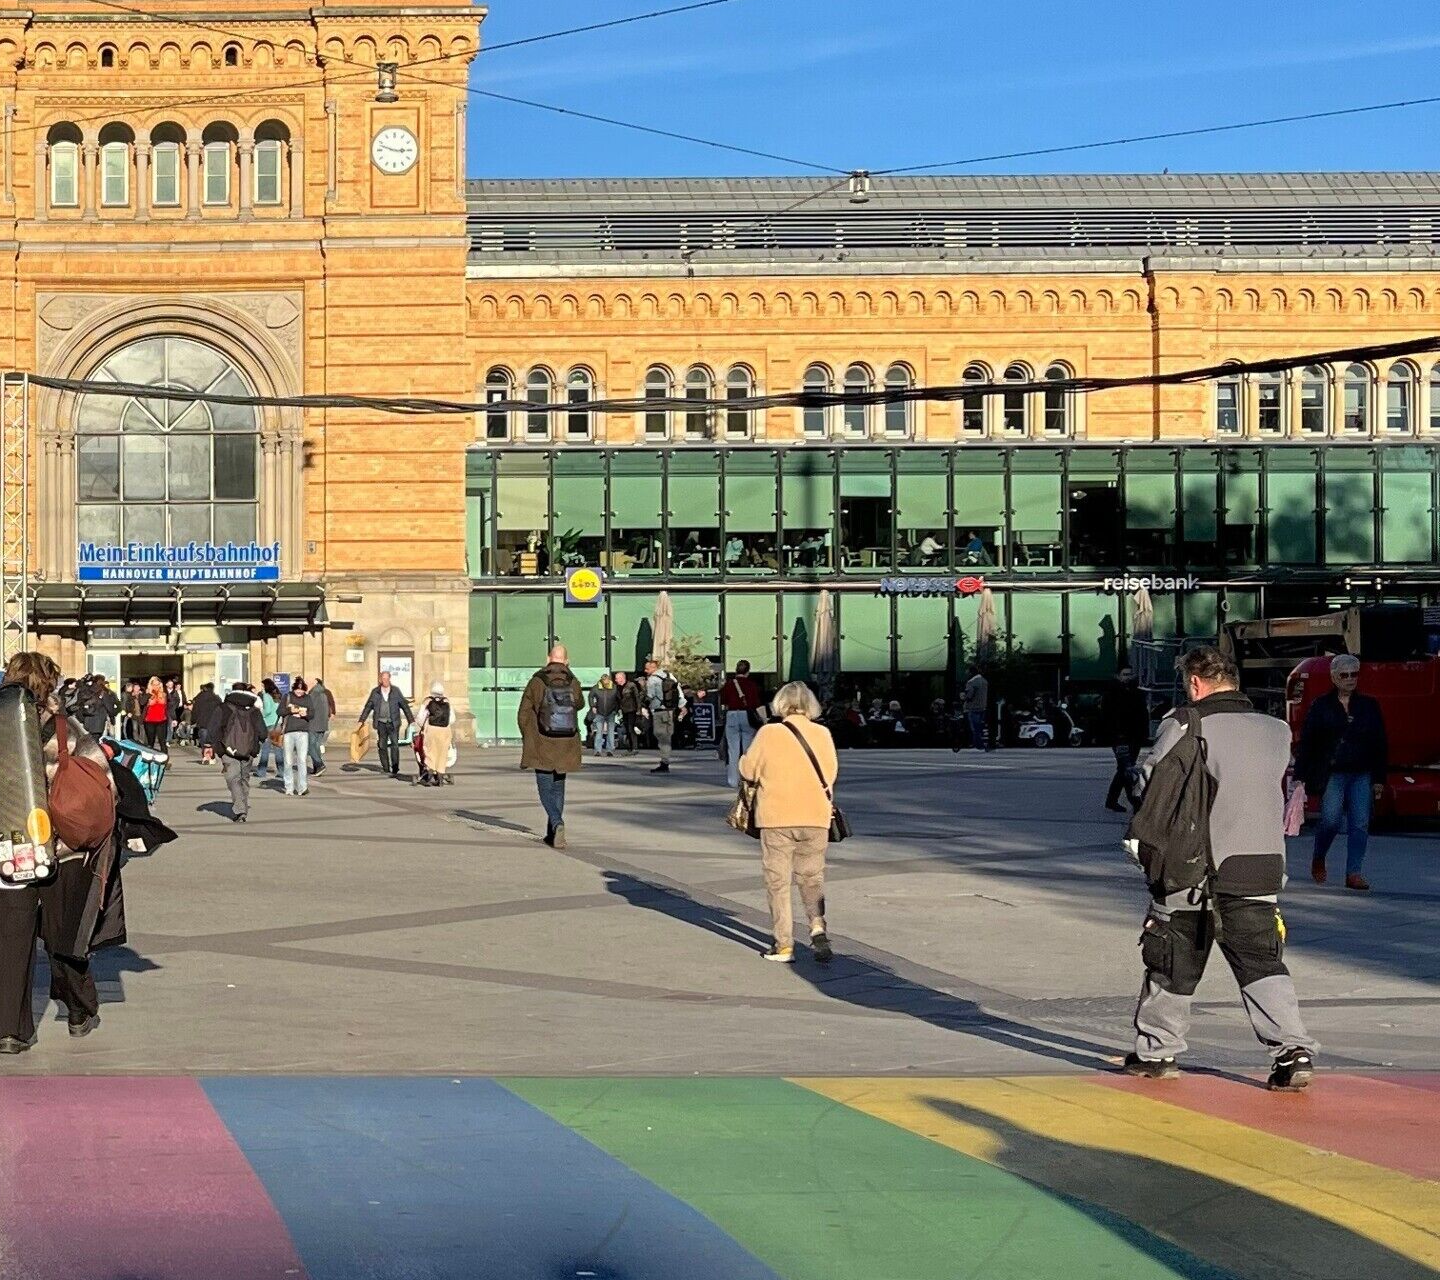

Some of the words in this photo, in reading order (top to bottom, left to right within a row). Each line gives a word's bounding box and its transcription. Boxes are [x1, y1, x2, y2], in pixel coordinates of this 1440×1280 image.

[78, 542, 123, 563] Mein
[127, 541, 280, 563] Einkaufsbahnhof
[102, 568, 163, 579] HANNOVER
[167, 568, 258, 579] HAUPTBAHNHOF
